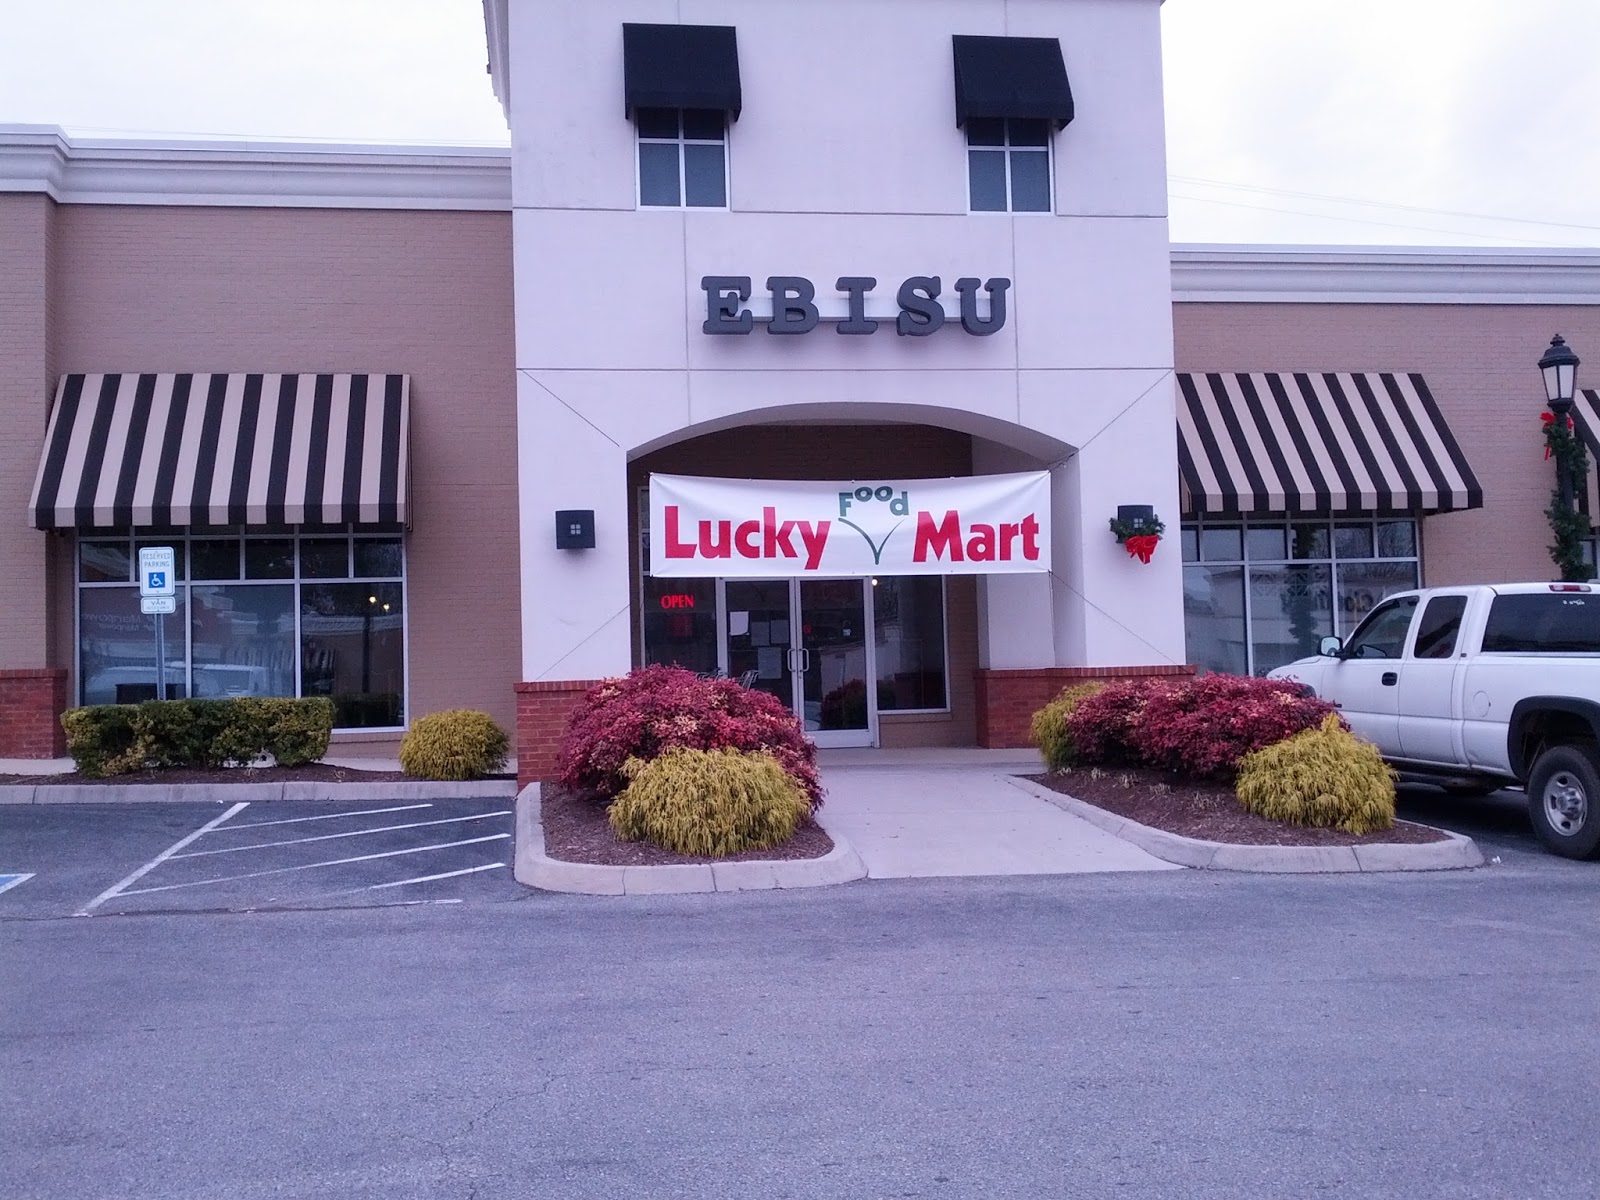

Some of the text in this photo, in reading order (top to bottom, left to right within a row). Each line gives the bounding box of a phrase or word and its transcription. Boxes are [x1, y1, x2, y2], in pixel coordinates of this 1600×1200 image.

[701, 276, 1011, 336] EBISU
[838, 485, 909, 517] Food
[664, 505, 1040, 570] Lucky Mart
[660, 594, 695, 609] OPEN
